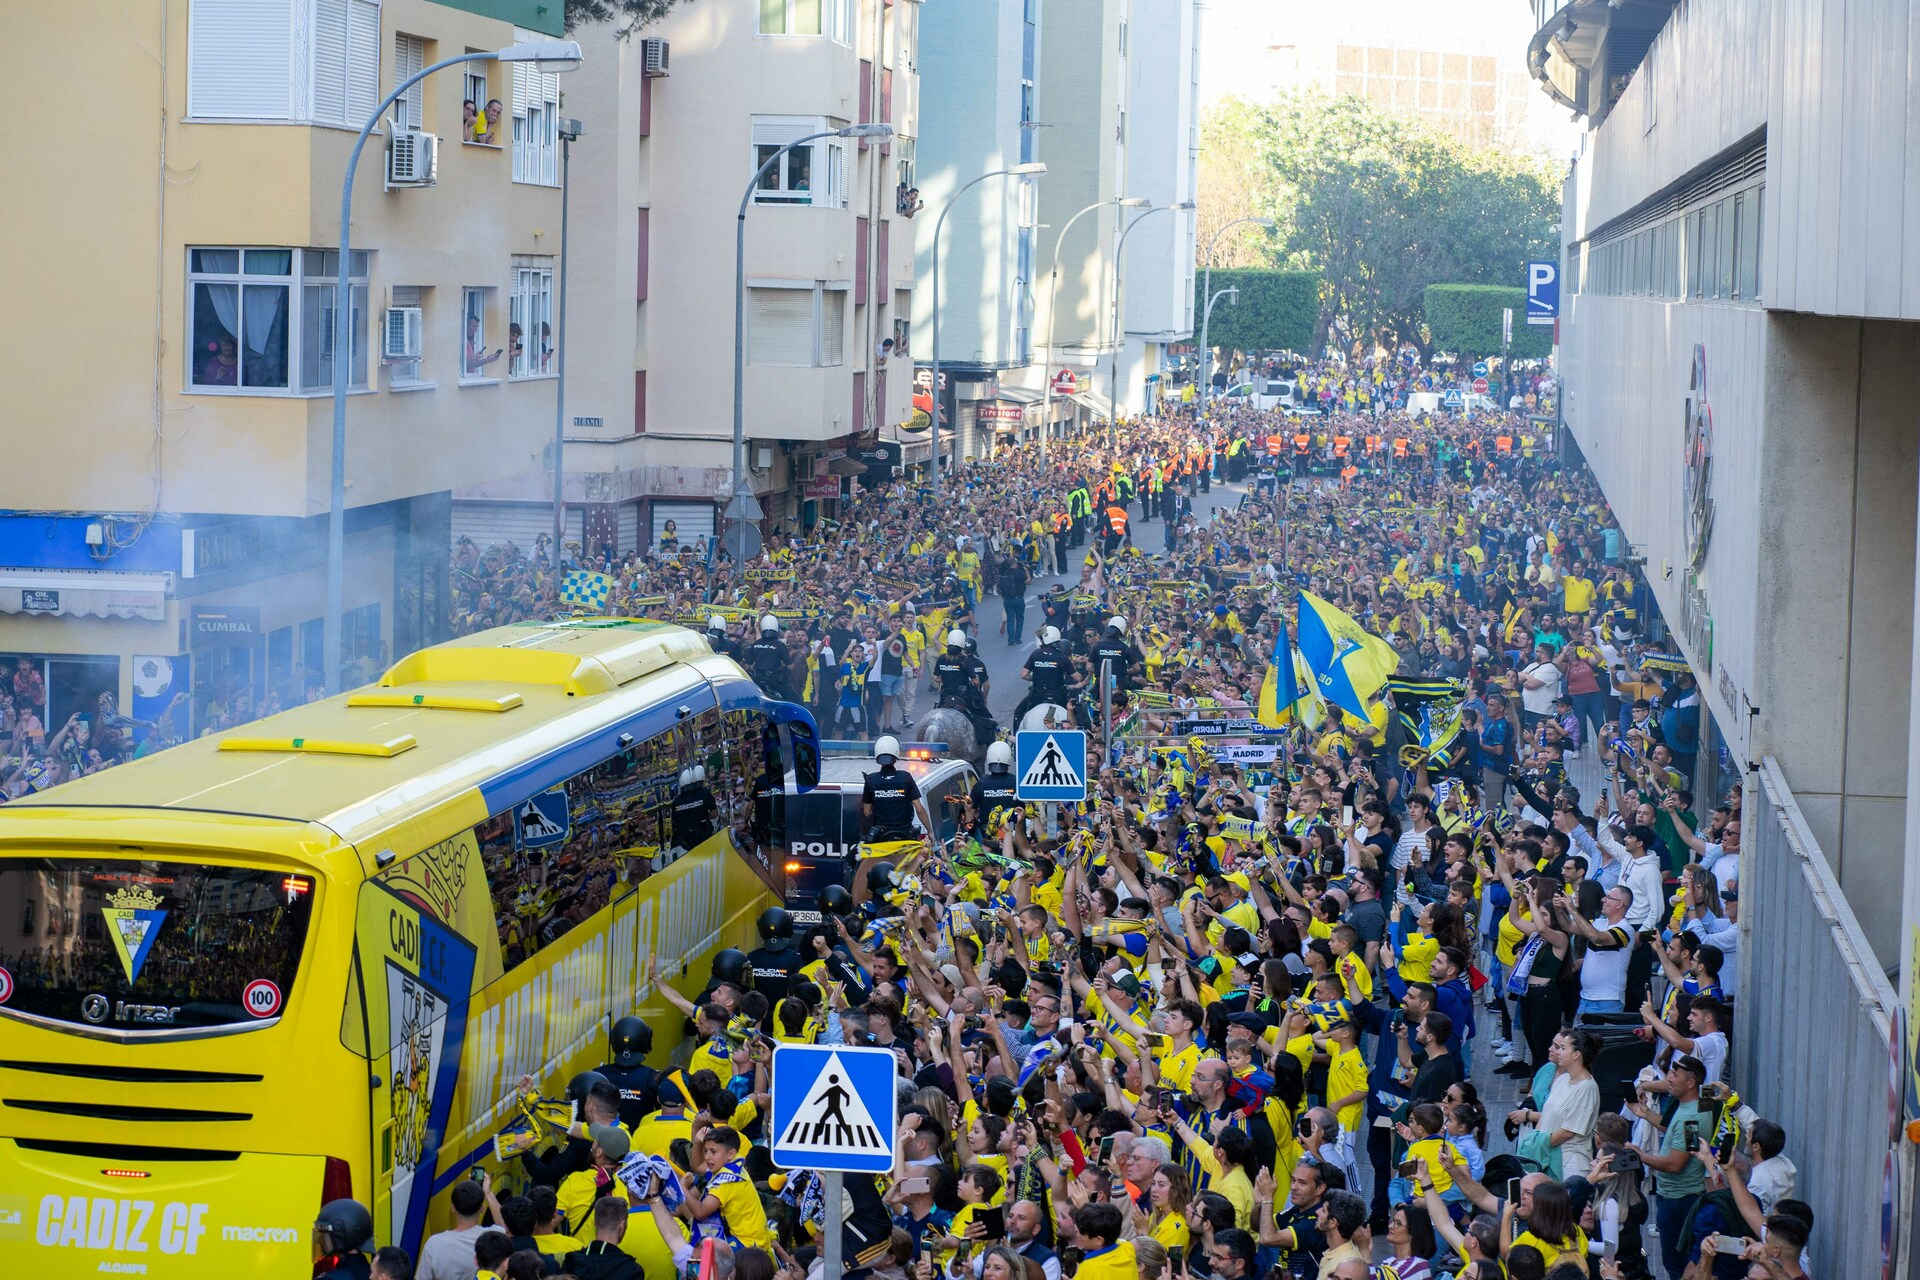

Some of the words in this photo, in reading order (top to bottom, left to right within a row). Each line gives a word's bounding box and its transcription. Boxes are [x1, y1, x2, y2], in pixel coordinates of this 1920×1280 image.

[1529, 264, 1555, 296] P
[980, 408, 1020, 418] Firestone
[746, 570, 775, 578] CADIZ
[198, 621, 253, 632] CUMBAL
[389, 908, 426, 970] CADIZ
[250, 990, 273, 1005] 100
[36, 1194, 155, 1253] CADIZ
[159, 1201, 209, 1255] CF
[222, 1225, 298, 1243] macron
[98, 1261, 147, 1275] ALOMPE
